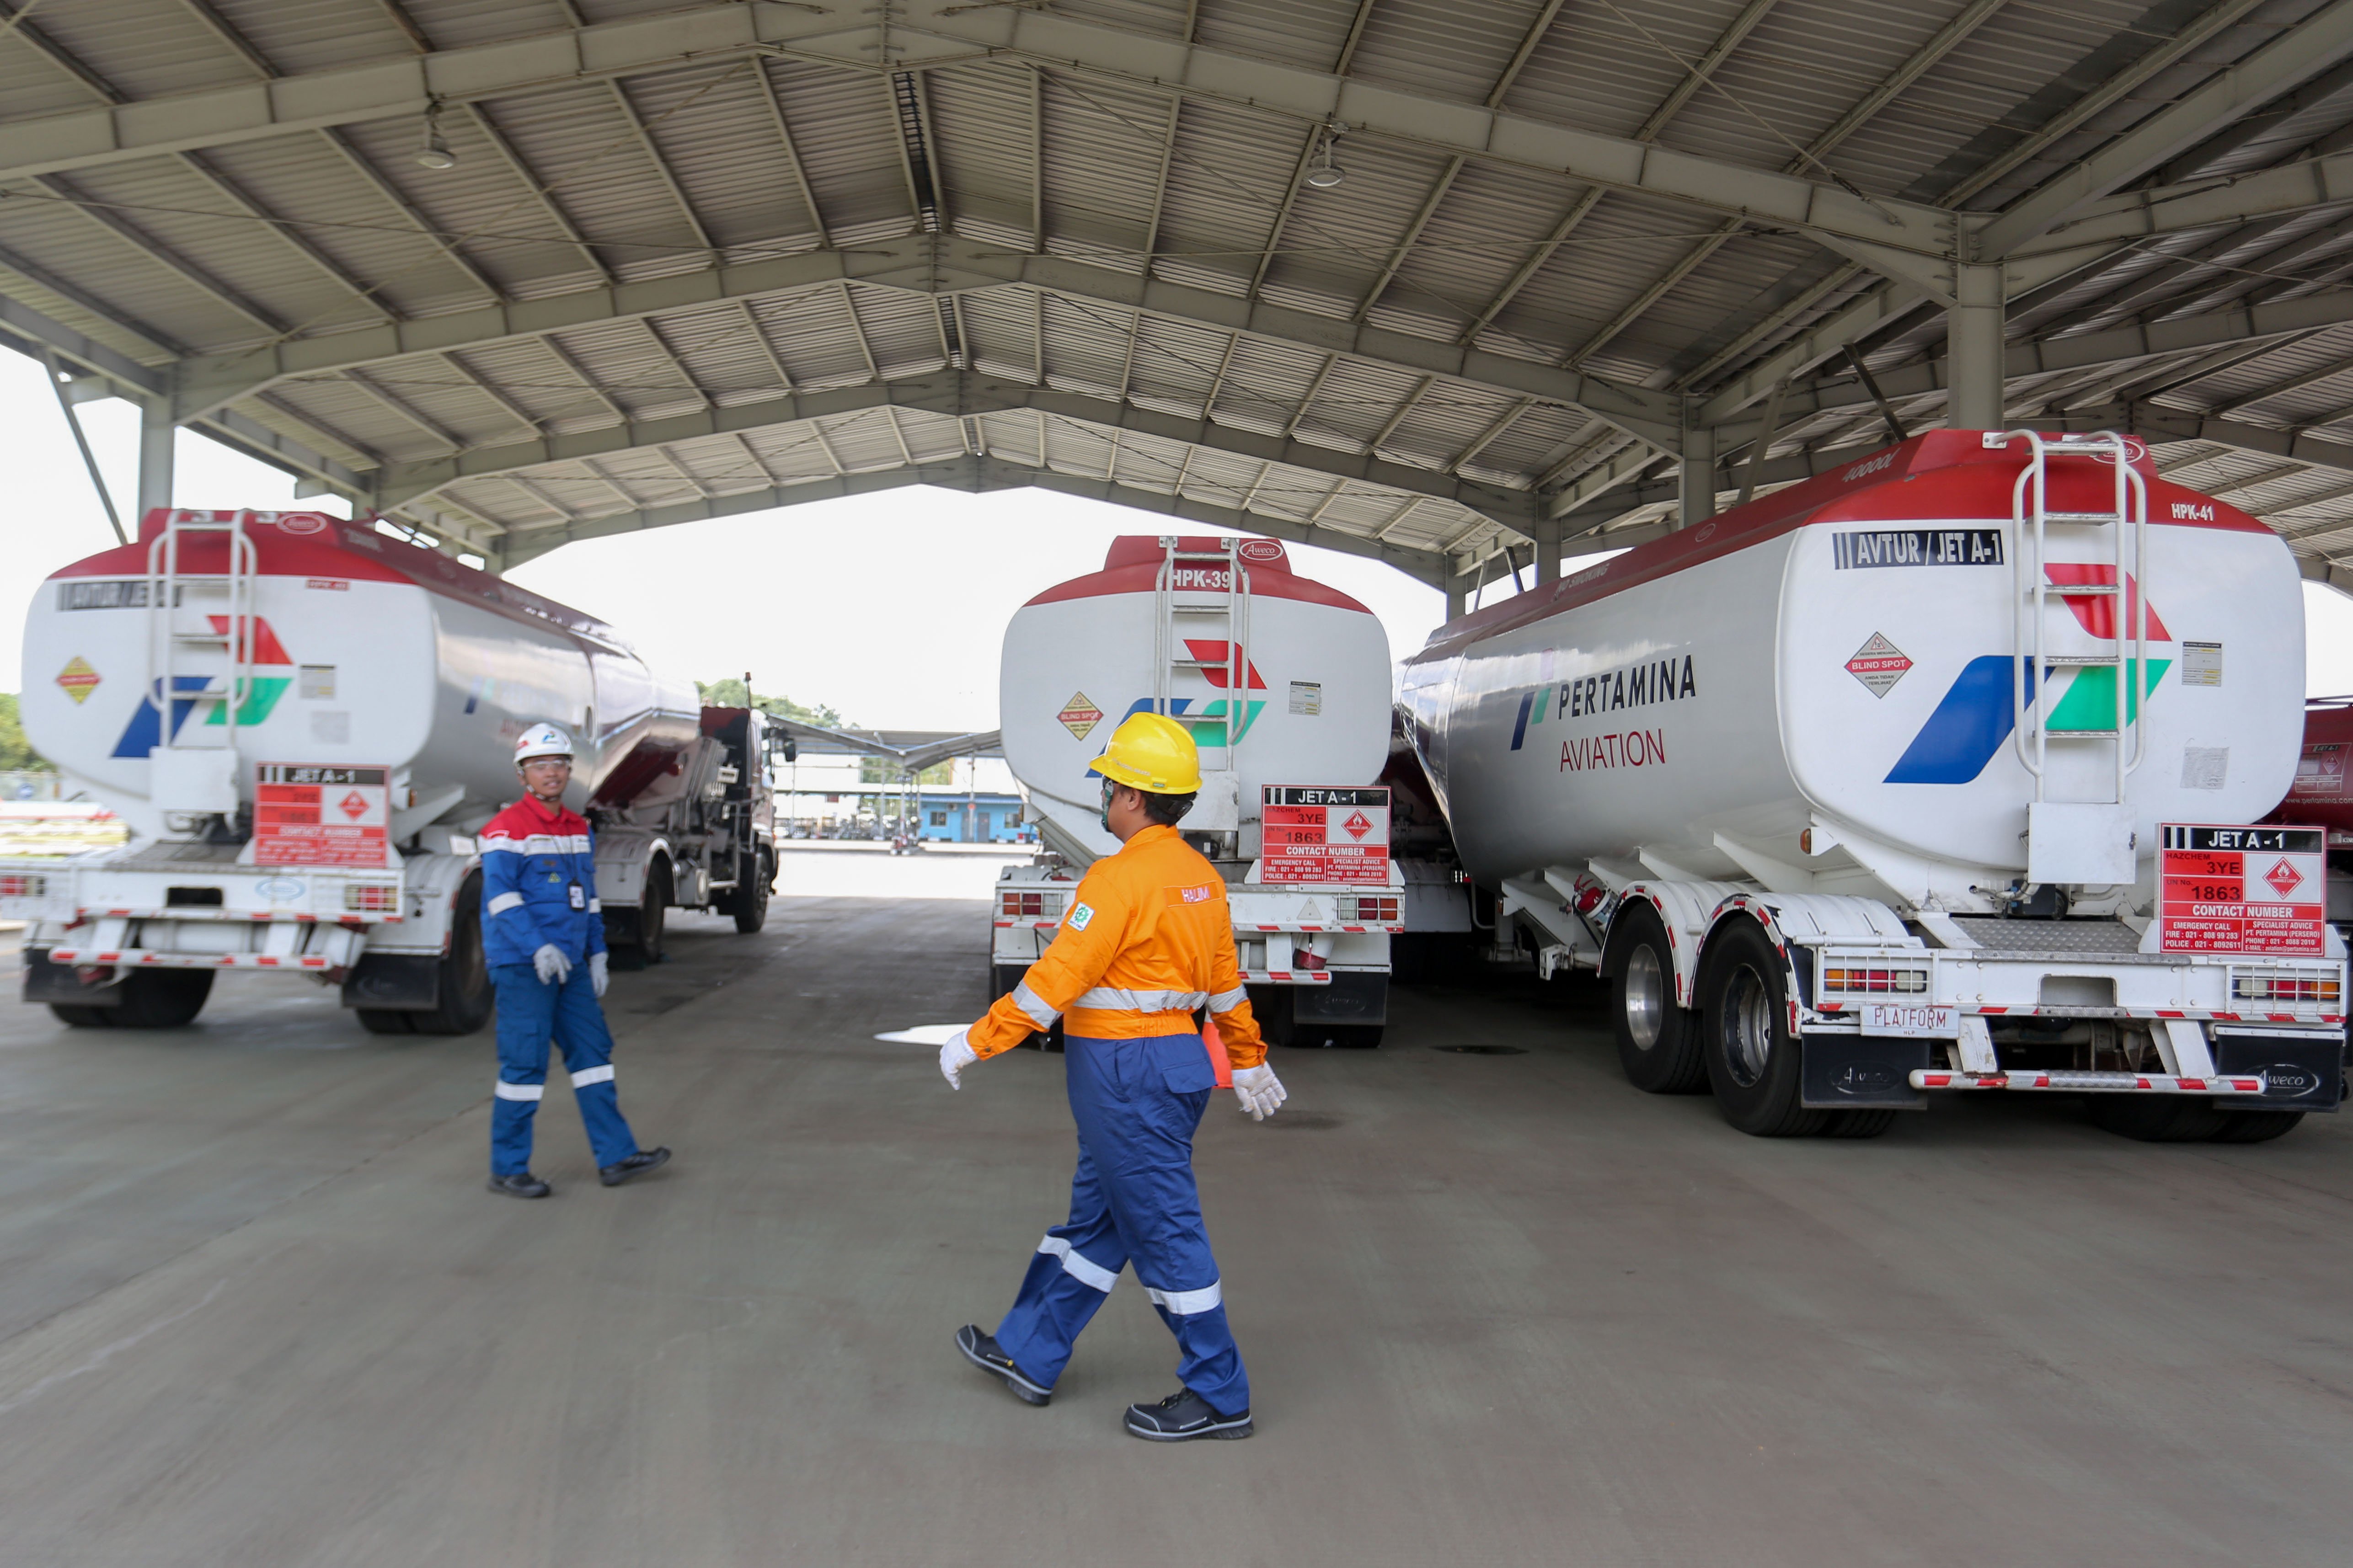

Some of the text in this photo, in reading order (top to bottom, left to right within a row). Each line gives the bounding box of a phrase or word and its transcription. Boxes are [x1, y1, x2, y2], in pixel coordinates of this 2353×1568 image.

[2171, 503, 2214, 521] HPK-41
[1857, 532, 2000, 565] AVTUR / JET A-1
[1173, 570, 1230, 588] HPK-39
[1852, 660, 1906, 670] BLIND SPOT
[1558, 655, 1695, 720] PERTAMINA
[1560, 729, 1665, 772] AVIATION
[1298, 790, 1324, 803] JET
[1327, 791, 1338, 804] A
[1350, 792, 1356, 804] 1
[1298, 814, 1323, 824] 3YE
[1285, 832, 1322, 843] 1863
[2208, 831, 2242, 847] JET
[2246, 832, 2259, 848] A
[2275, 832, 2283, 848] 1
[1286, 846, 1365, 856] CONTACT NUMBER
[2207, 862, 2240, 874] 3YE
[1181, 885, 1211, 903] HALIM
[2191, 886, 2240, 900] 1863
[2193, 905, 2293, 917] CONTACT NUMBER
[2173, 922, 2213, 930] EMERGENCY
[1875, 1007, 1946, 1028] PLATFORM
